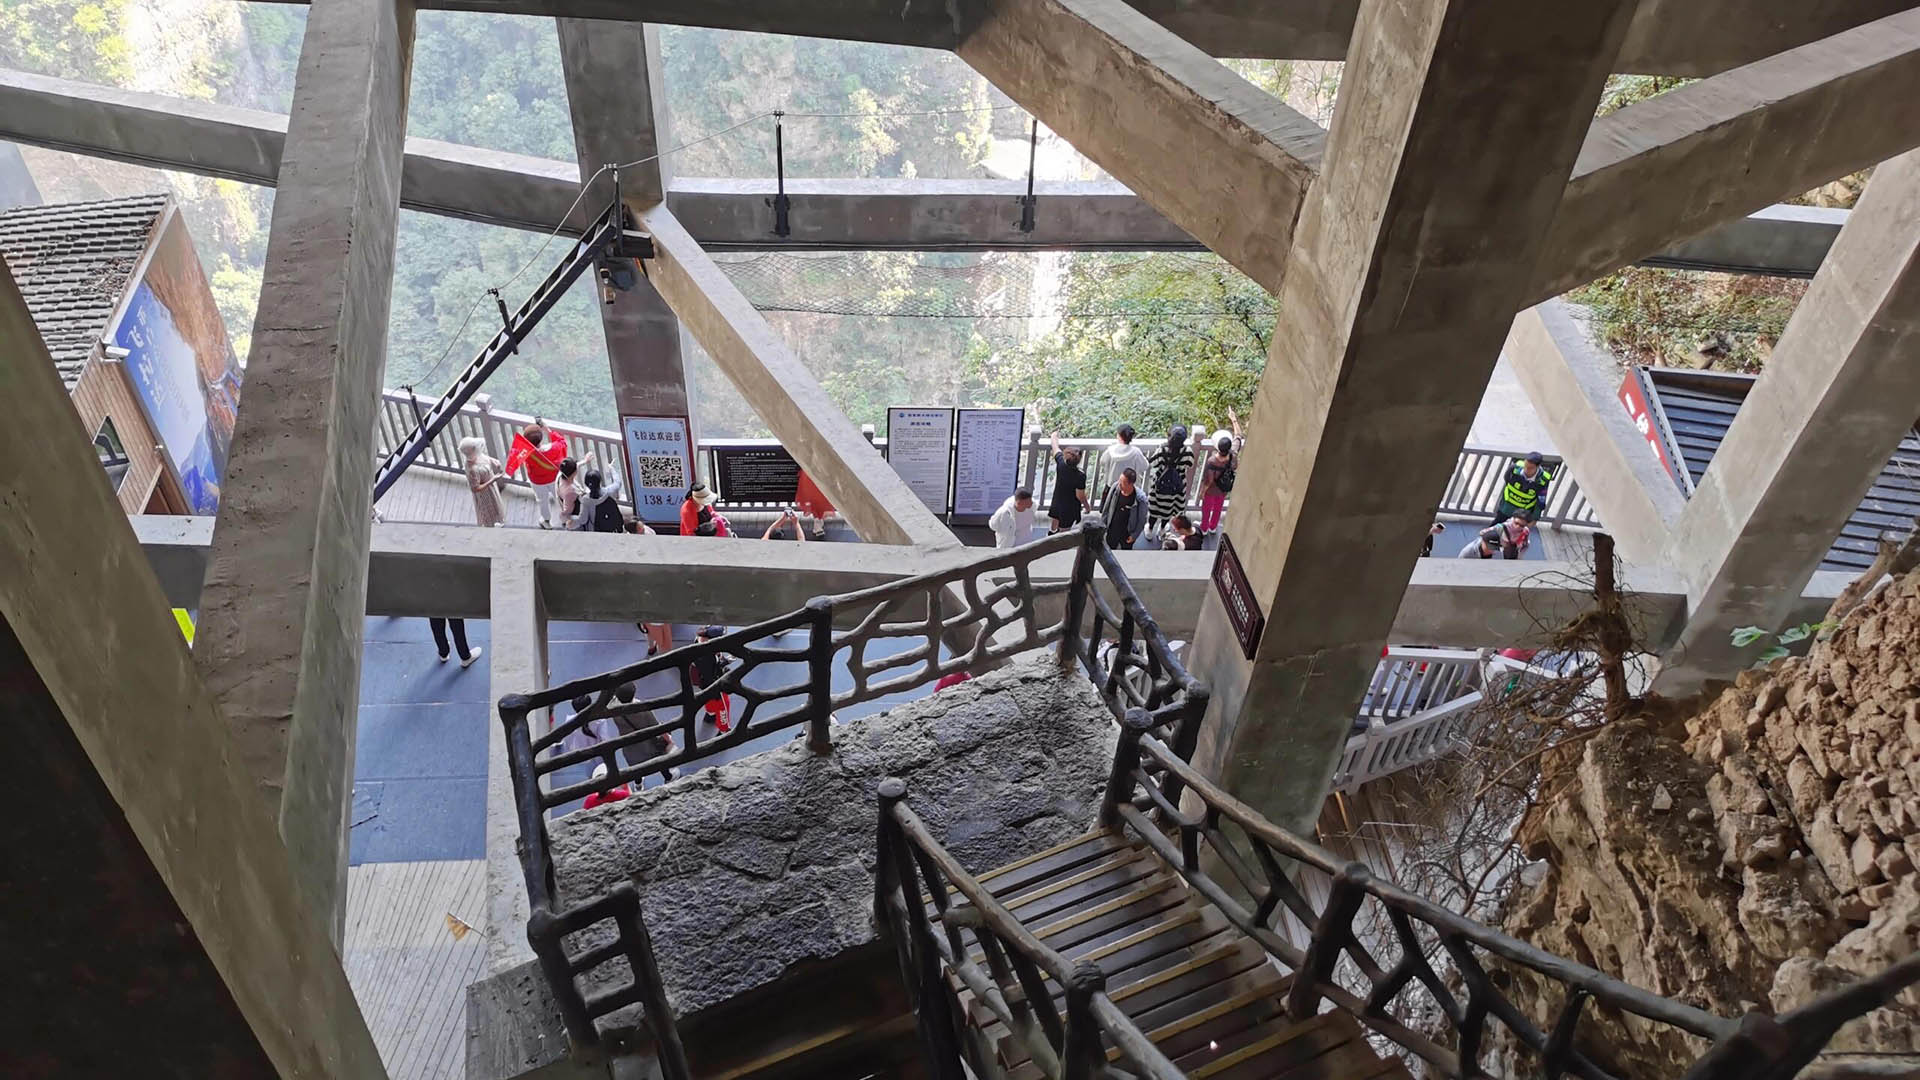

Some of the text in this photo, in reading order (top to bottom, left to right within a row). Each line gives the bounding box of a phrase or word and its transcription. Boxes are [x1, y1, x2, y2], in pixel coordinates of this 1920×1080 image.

[633, 431, 681, 441] 飞拉达欢迎您
